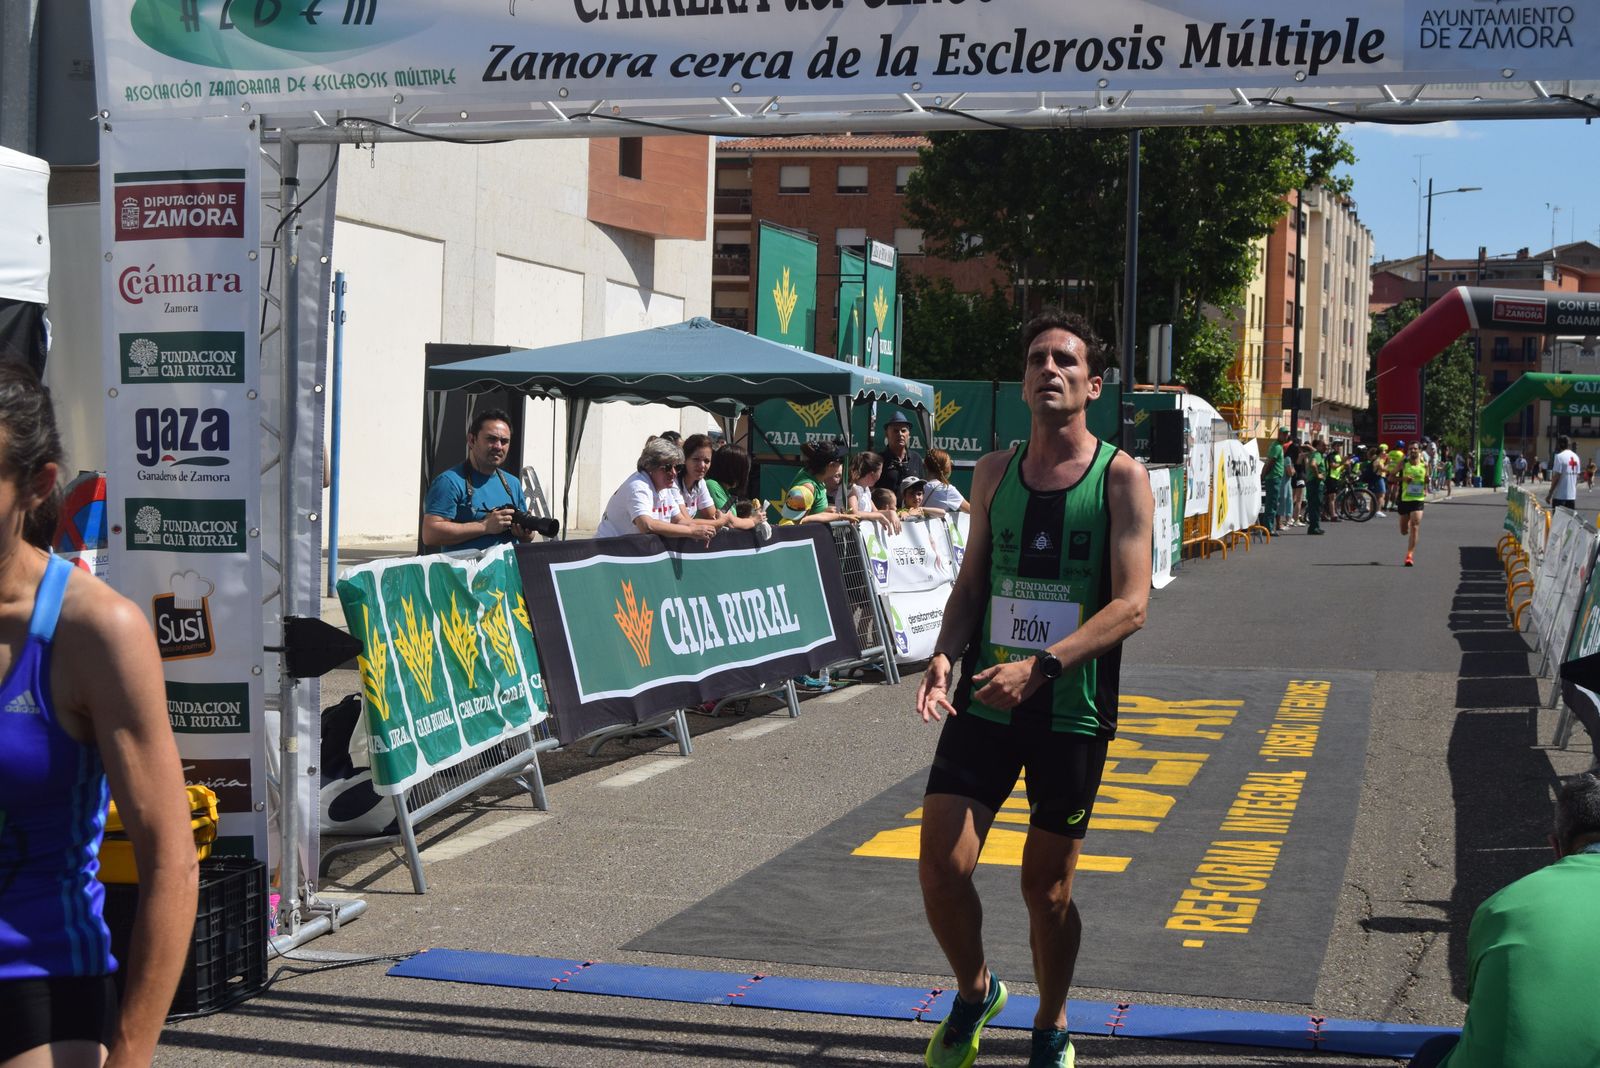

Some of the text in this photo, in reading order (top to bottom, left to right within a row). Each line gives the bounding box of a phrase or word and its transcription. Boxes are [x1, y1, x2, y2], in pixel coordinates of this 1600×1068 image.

[1421, 6, 1574, 26] AYUNTAMIENTO
[1420, 26, 1574, 49] DE ZAMORA
[482, 17, 1385, 82] Zamora cerca de la Esclerosis Múltiple
[124, 67, 456, 102] ASOCIACIÓN ZAMORANA DE ESCLEROSIS MÚLTIPLE
[144, 193, 237, 207] DIPUTACIÓN DE
[143, 208, 238, 228] ZAMORA
[164, 302, 199, 313] Zamora
[1558, 299, 1585, 311] CON
[1505, 309, 1543, 319] ZAMORA
[161, 350, 236, 364] FUNDACION
[161, 364, 236, 377] CAJA RURAL
[1574, 381, 1600, 394] CAJ
[135, 407, 230, 467] gaza
[764, 431, 800, 446] CAJA
[932, 436, 982, 451] RURAL
[137, 470, 230, 482] Ganaderos de Zamora
[162, 520, 238, 533] FUNDACION
[163, 533, 238, 546] CAJA RURAL
[1015, 580, 1071, 594] FUNDACION
[1014, 590, 1070, 601] CAJA RURAL
[1010, 603, 1015, 615] 4
[159, 610, 205, 644] Susi
[660, 584, 800, 656] CAJA RURAL
[1011, 615, 1050, 643] PEÓN
[4, 704, 41, 714] adidas
[169, 714, 241, 727] AJA RURAL
[1165, 680, 1331, 934] REFORMA INTEGRAL DISEÑO INTERIORES
